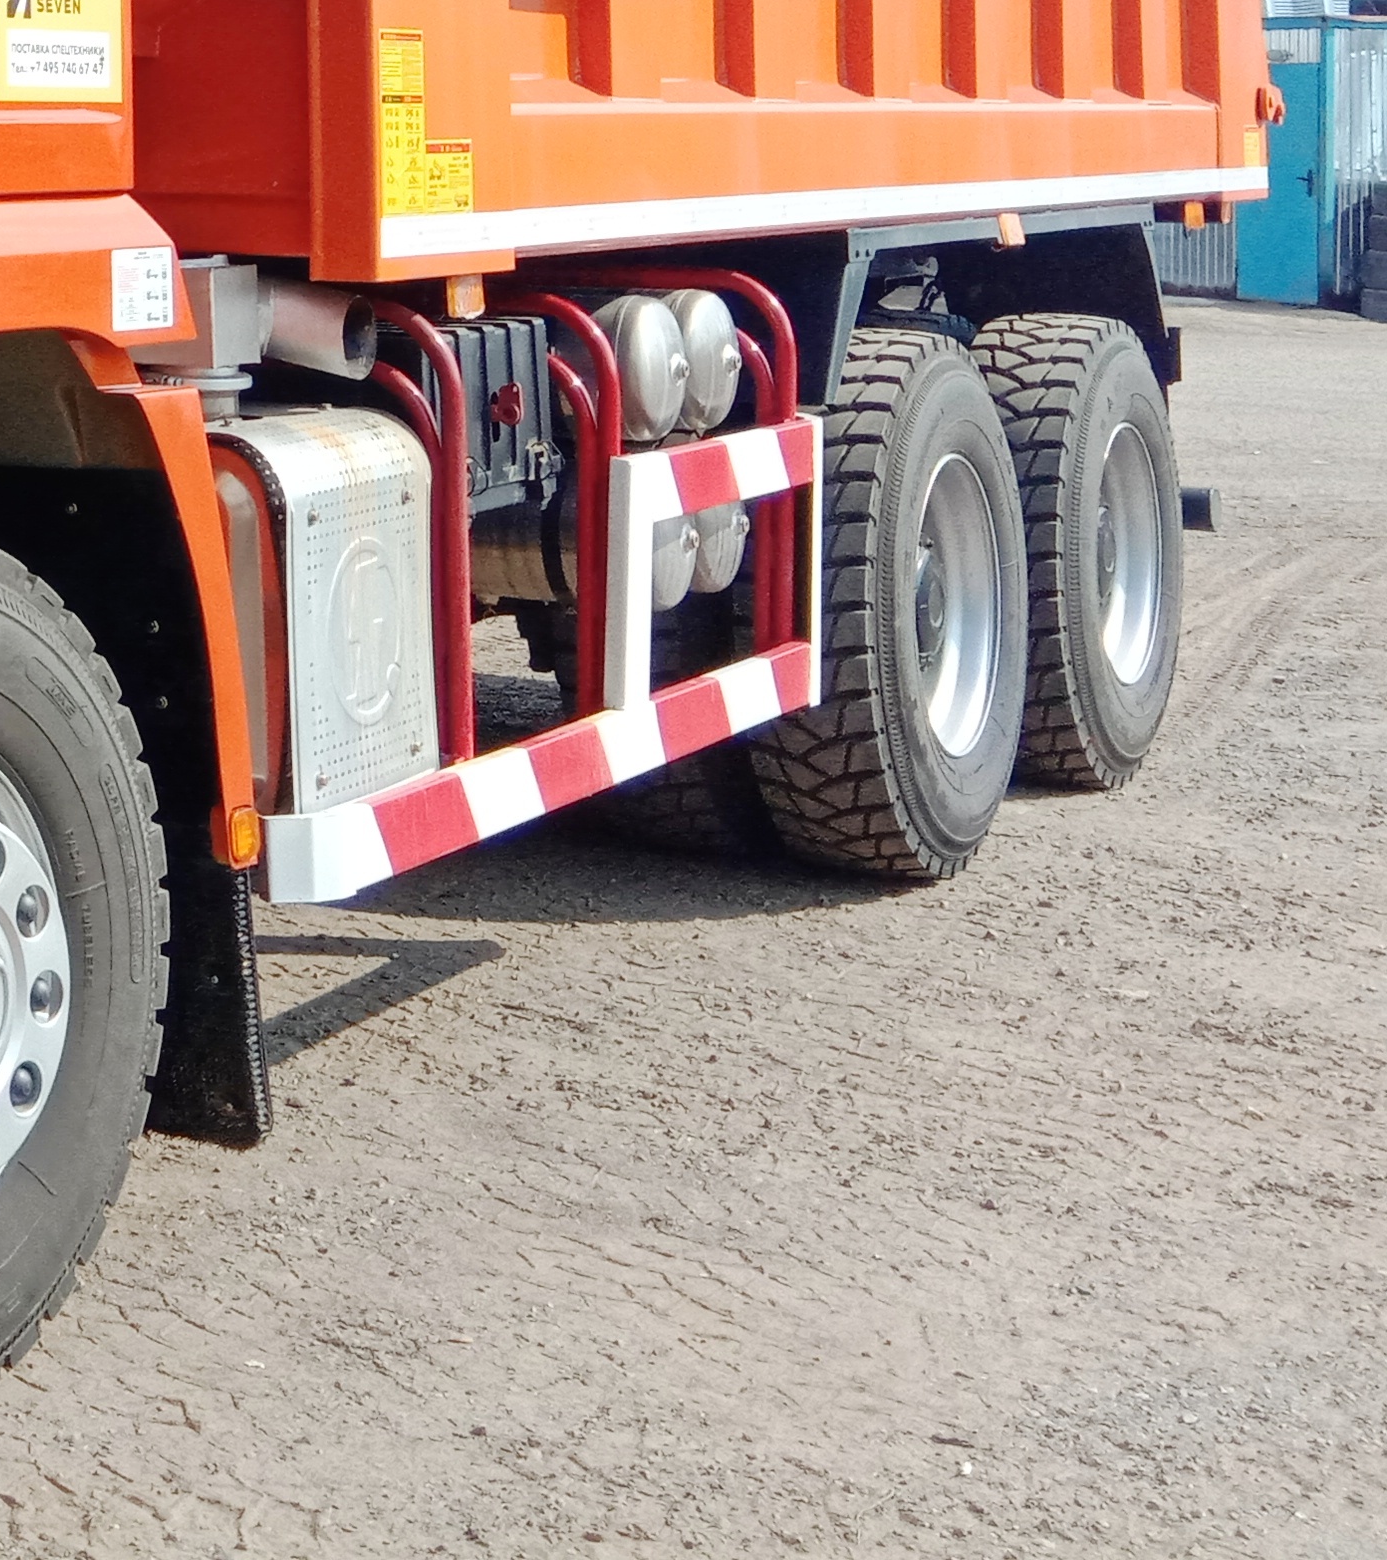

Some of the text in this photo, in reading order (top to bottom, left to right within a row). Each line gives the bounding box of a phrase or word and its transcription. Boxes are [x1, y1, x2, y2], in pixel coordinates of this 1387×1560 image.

[11, 43, 105, 56] ПОСТАВКА СПЕЦТЕХНИКИ
[43, 61, 59, 74] 495
[61, 62, 77, 75] 740
[78, 62, 90, 75] 67
